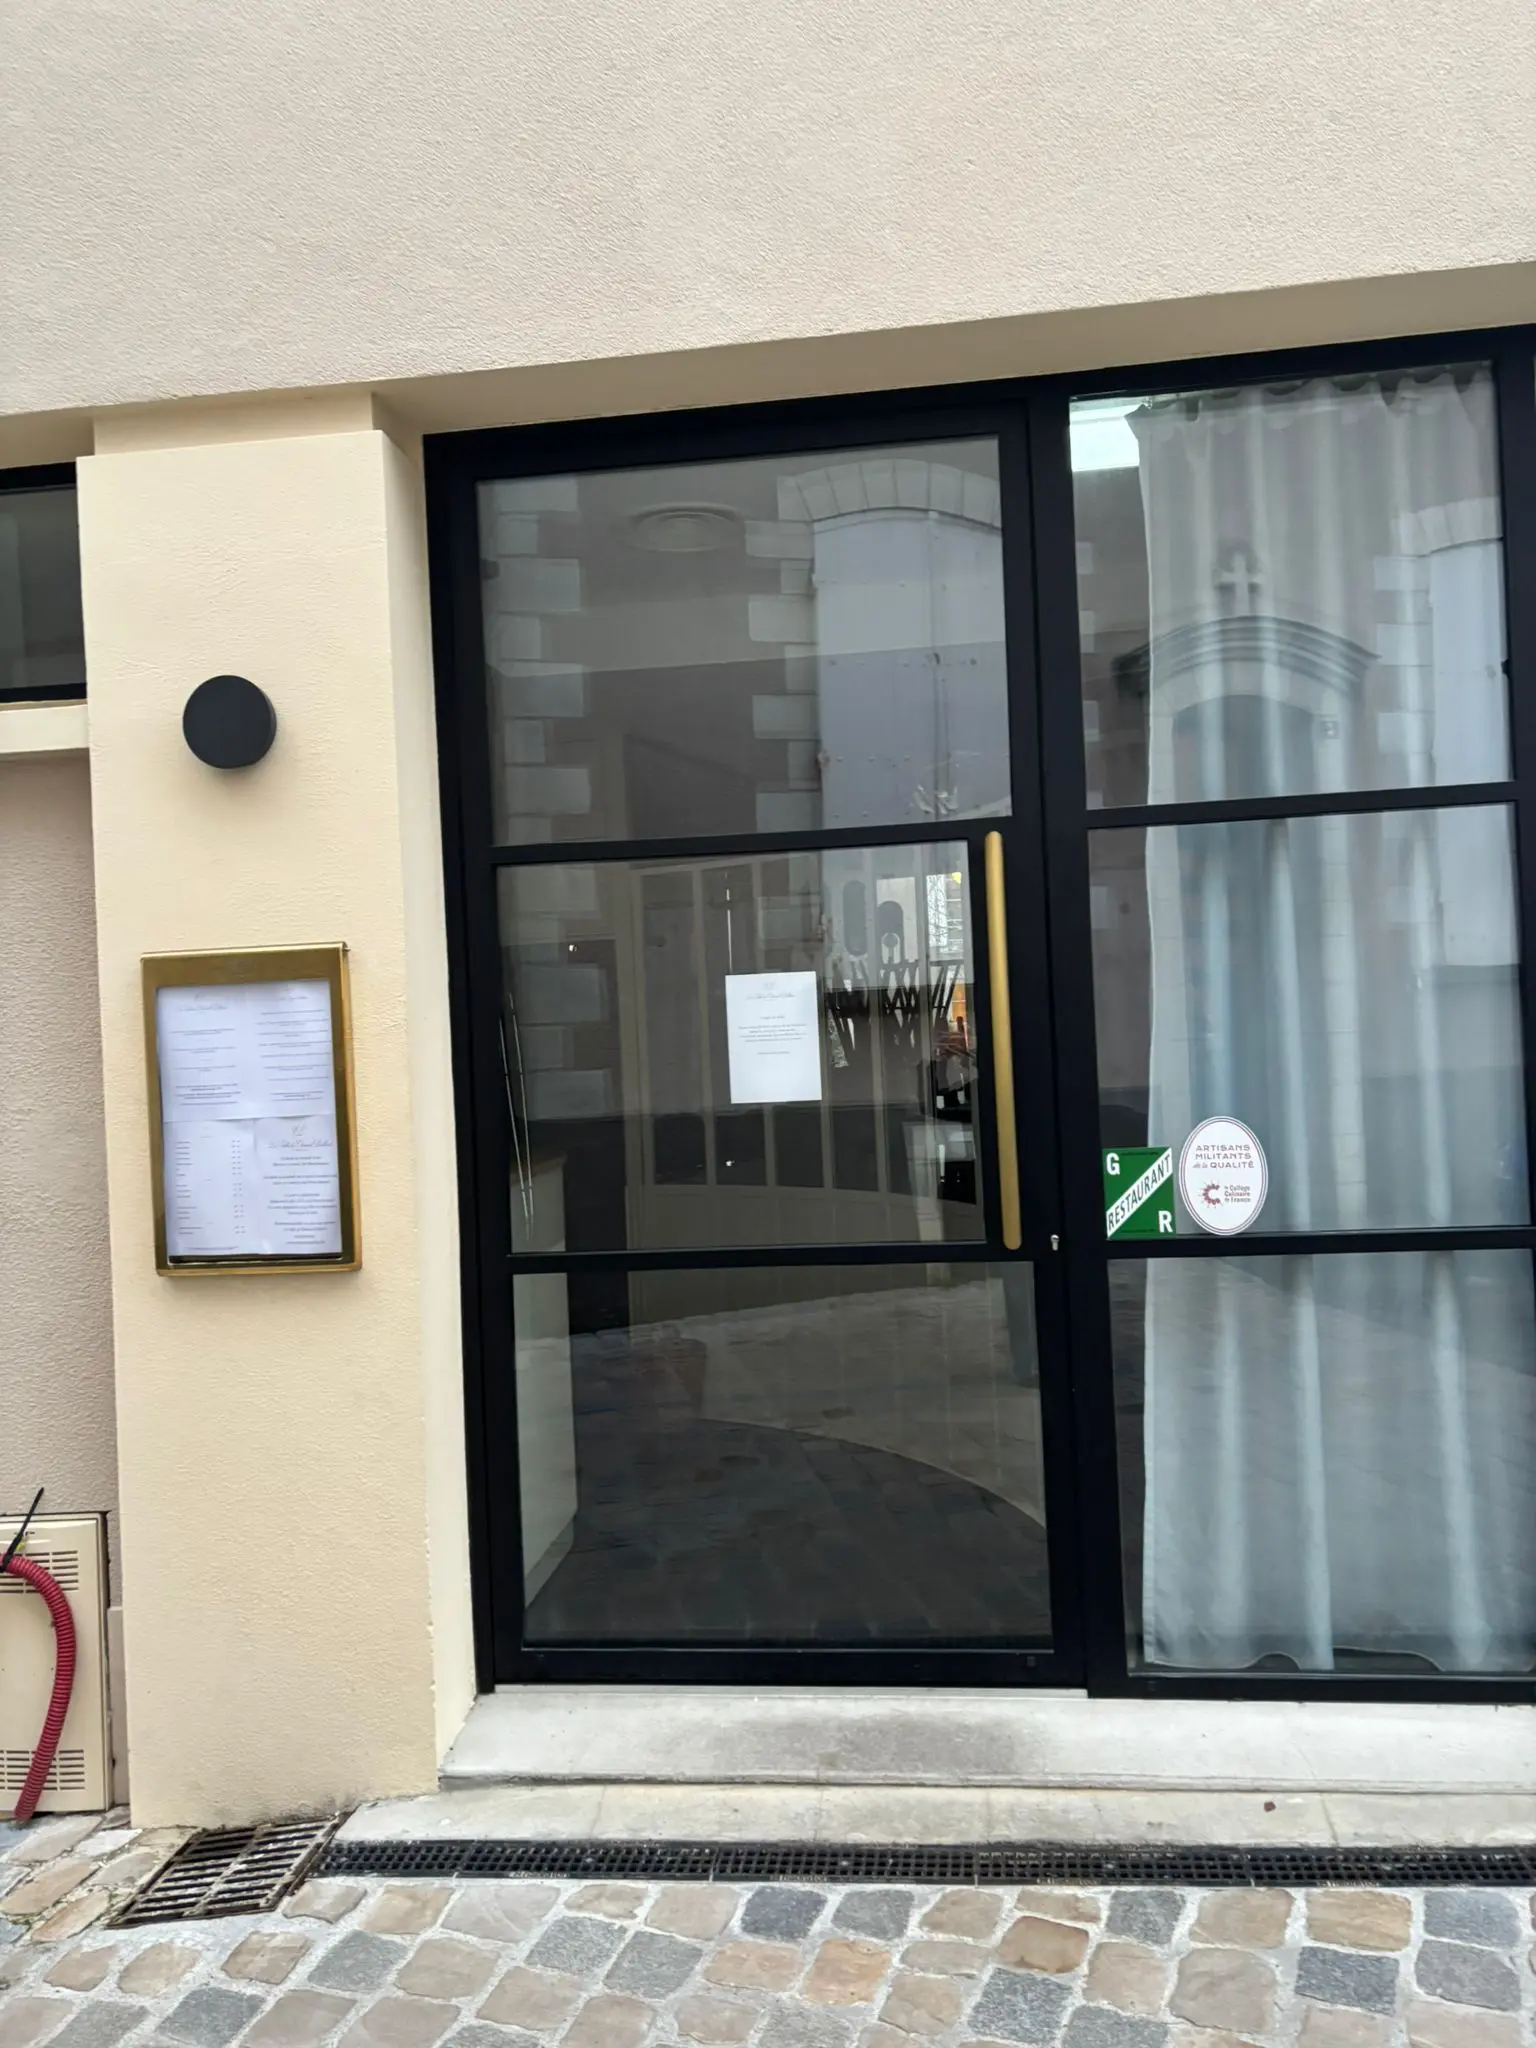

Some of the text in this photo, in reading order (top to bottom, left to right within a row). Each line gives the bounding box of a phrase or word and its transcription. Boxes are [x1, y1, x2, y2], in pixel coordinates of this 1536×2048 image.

[1195, 1144, 1251, 1152] ARTISANS
[1195, 1152, 1252, 1160] MILITANTS
[1106, 1152, 1120, 1176] G
[1209, 1160, 1255, 1169] QUALITÉ
[1107, 1154, 1172, 1229] RESTAURANT
[1158, 1210, 1173, 1233] R
